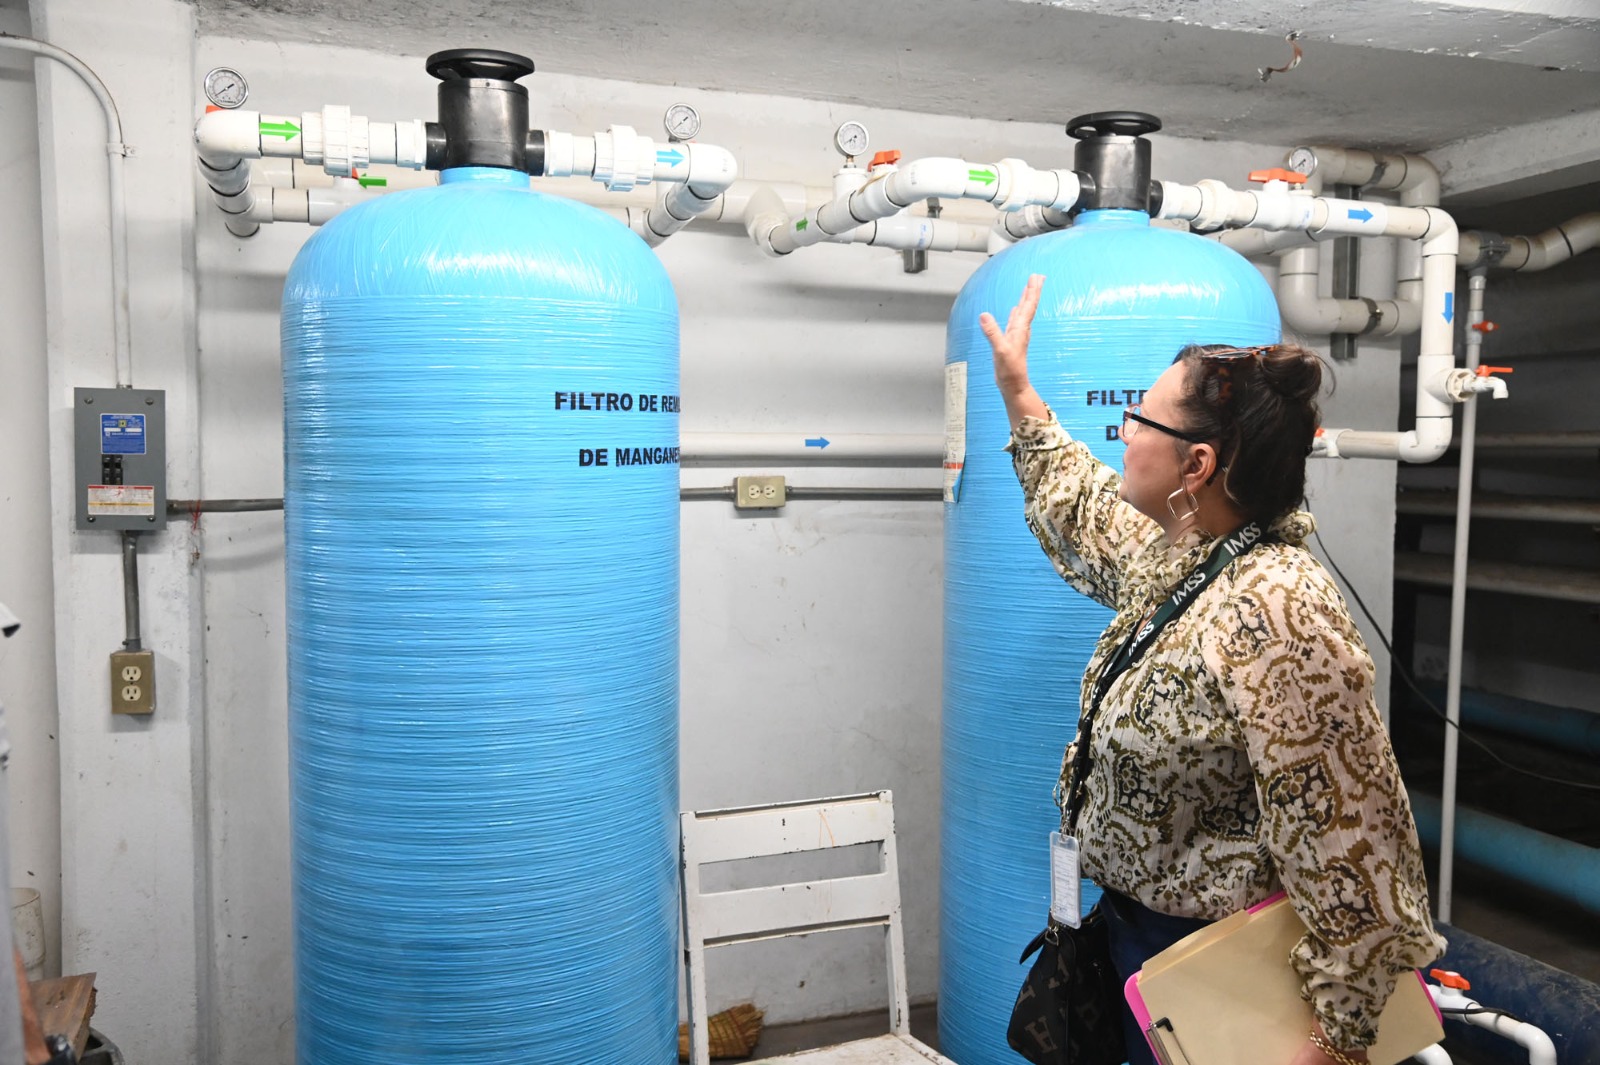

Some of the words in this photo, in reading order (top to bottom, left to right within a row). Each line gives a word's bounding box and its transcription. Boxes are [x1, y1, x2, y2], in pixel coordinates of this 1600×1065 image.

[555, 391, 633, 411] FILTRO
[639, 394, 658, 412] DE
[579, 448, 608, 467] DE
[616, 446, 680, 467] MANGANE
[1223, 522, 1262, 557] IMSS
[1171, 568, 1206, 606] IMSS
[1128, 621, 1155, 657] IMSS
